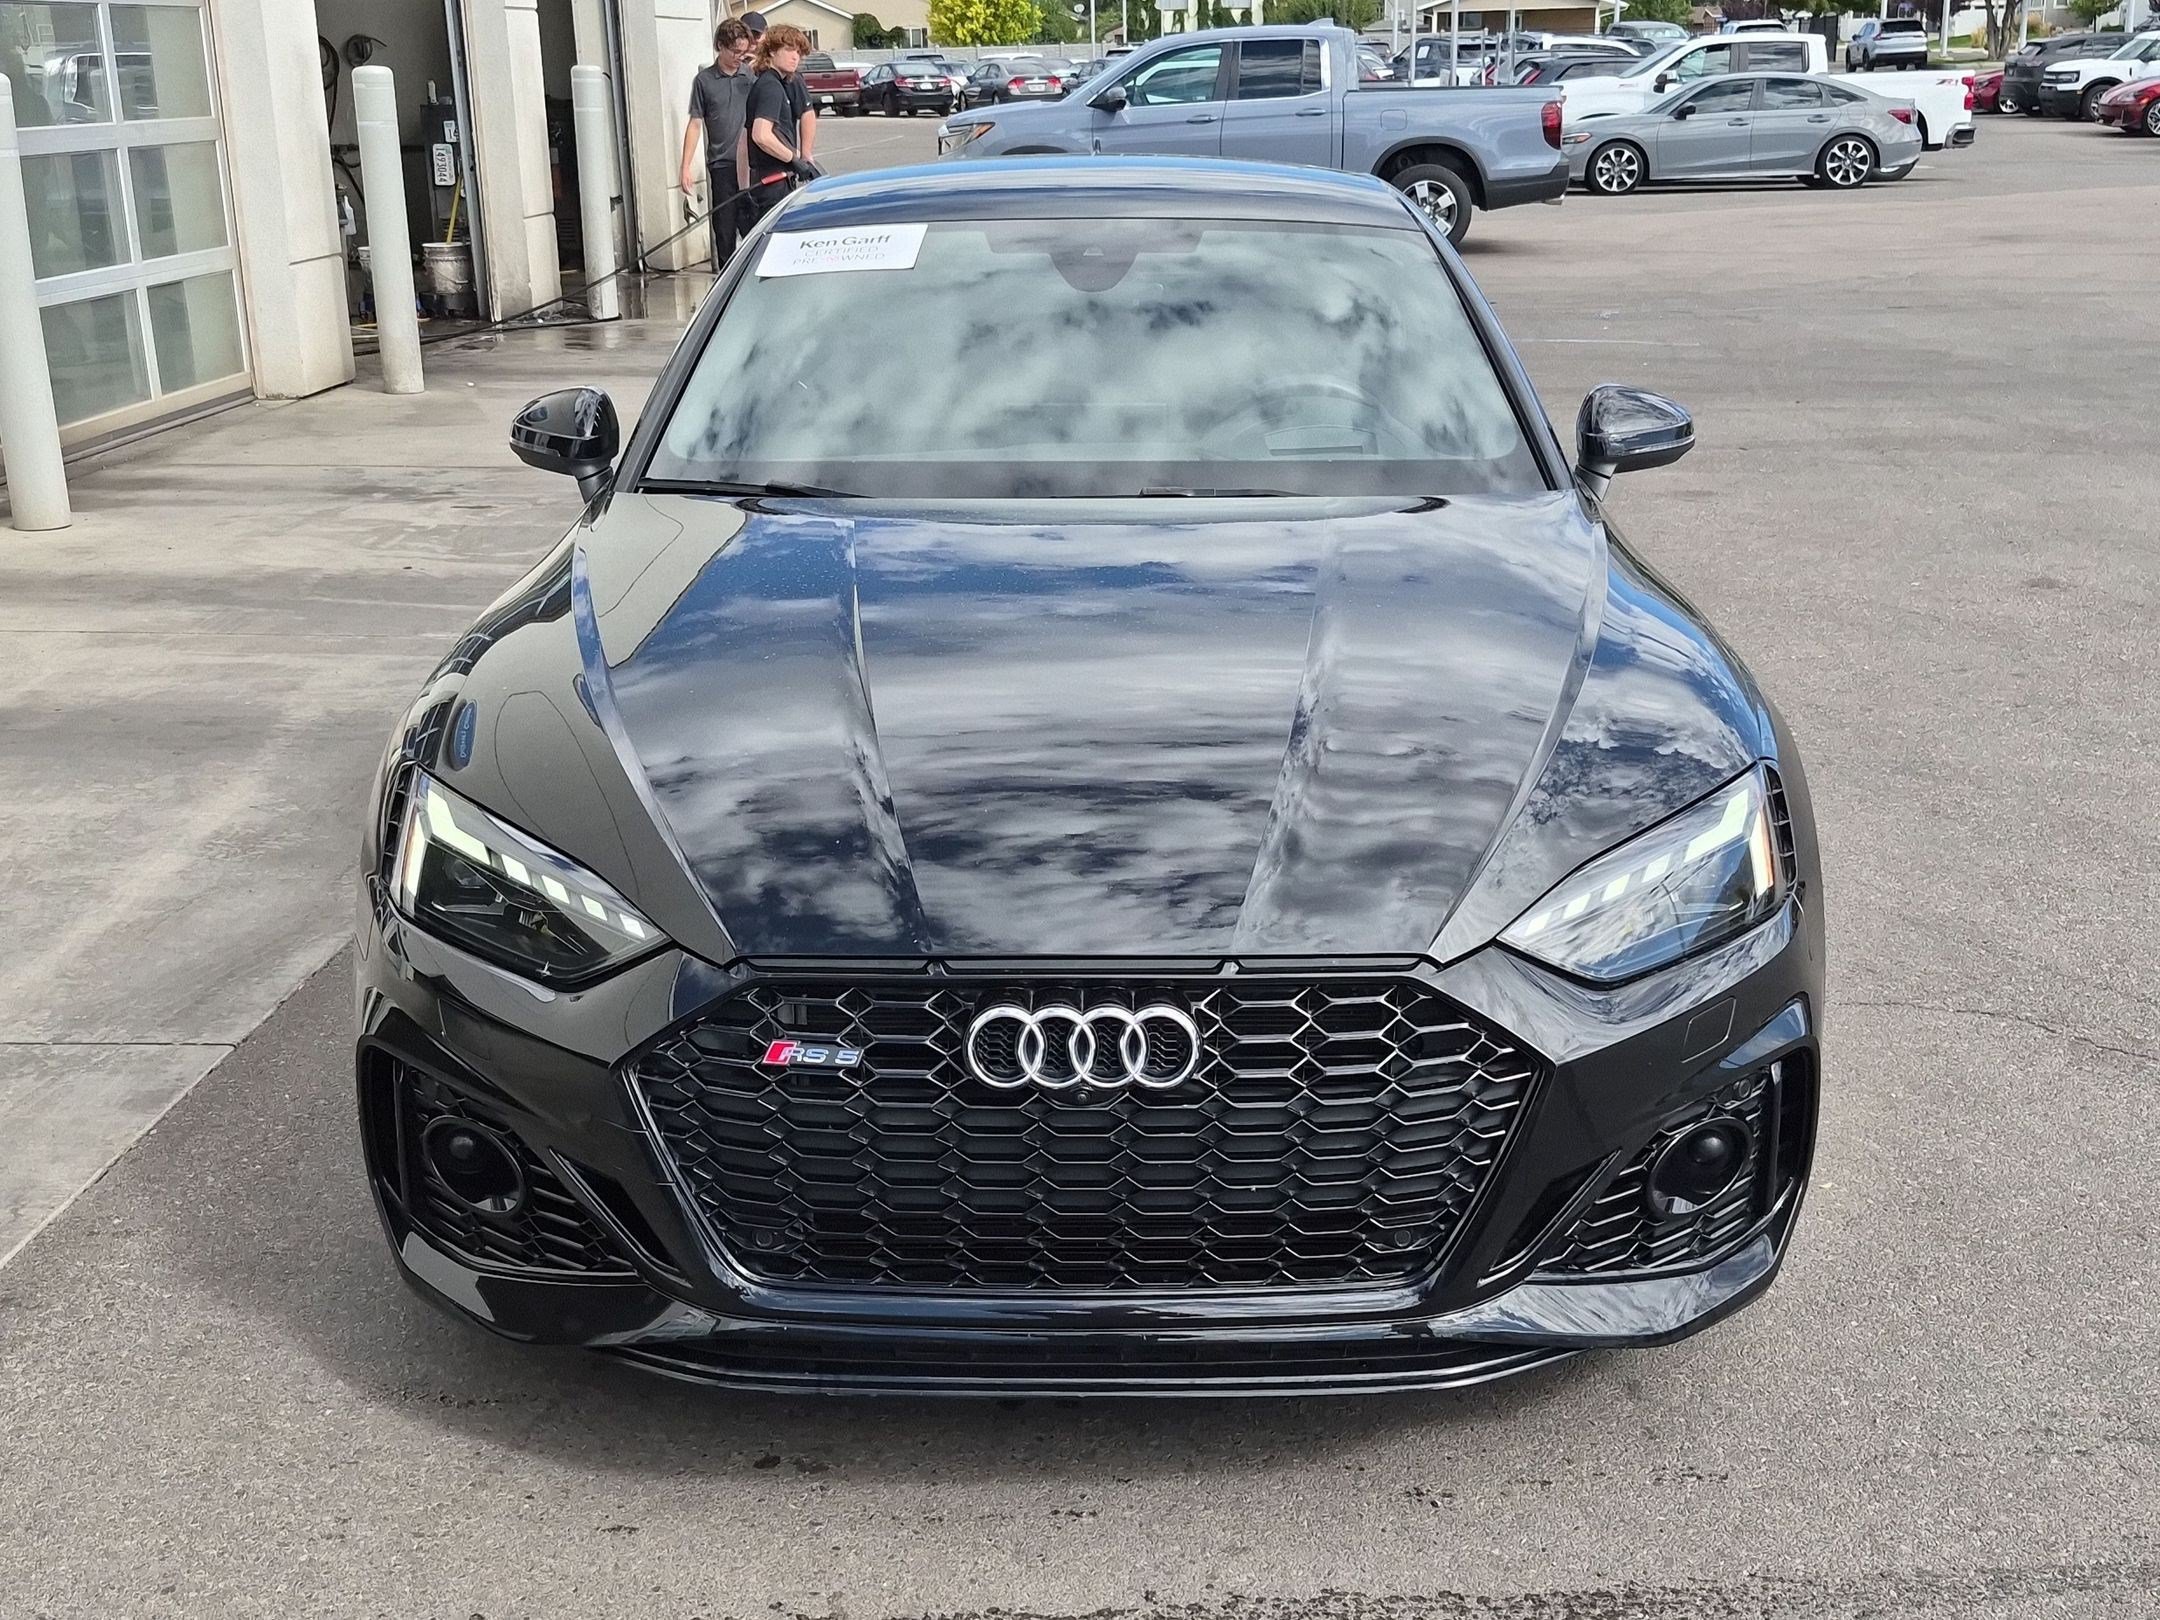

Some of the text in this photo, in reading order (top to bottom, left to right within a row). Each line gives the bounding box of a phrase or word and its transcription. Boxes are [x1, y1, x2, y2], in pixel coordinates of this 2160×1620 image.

[800, 234, 892, 249] Ken Garff
[804, 246, 880, 257] CERTIFIED
